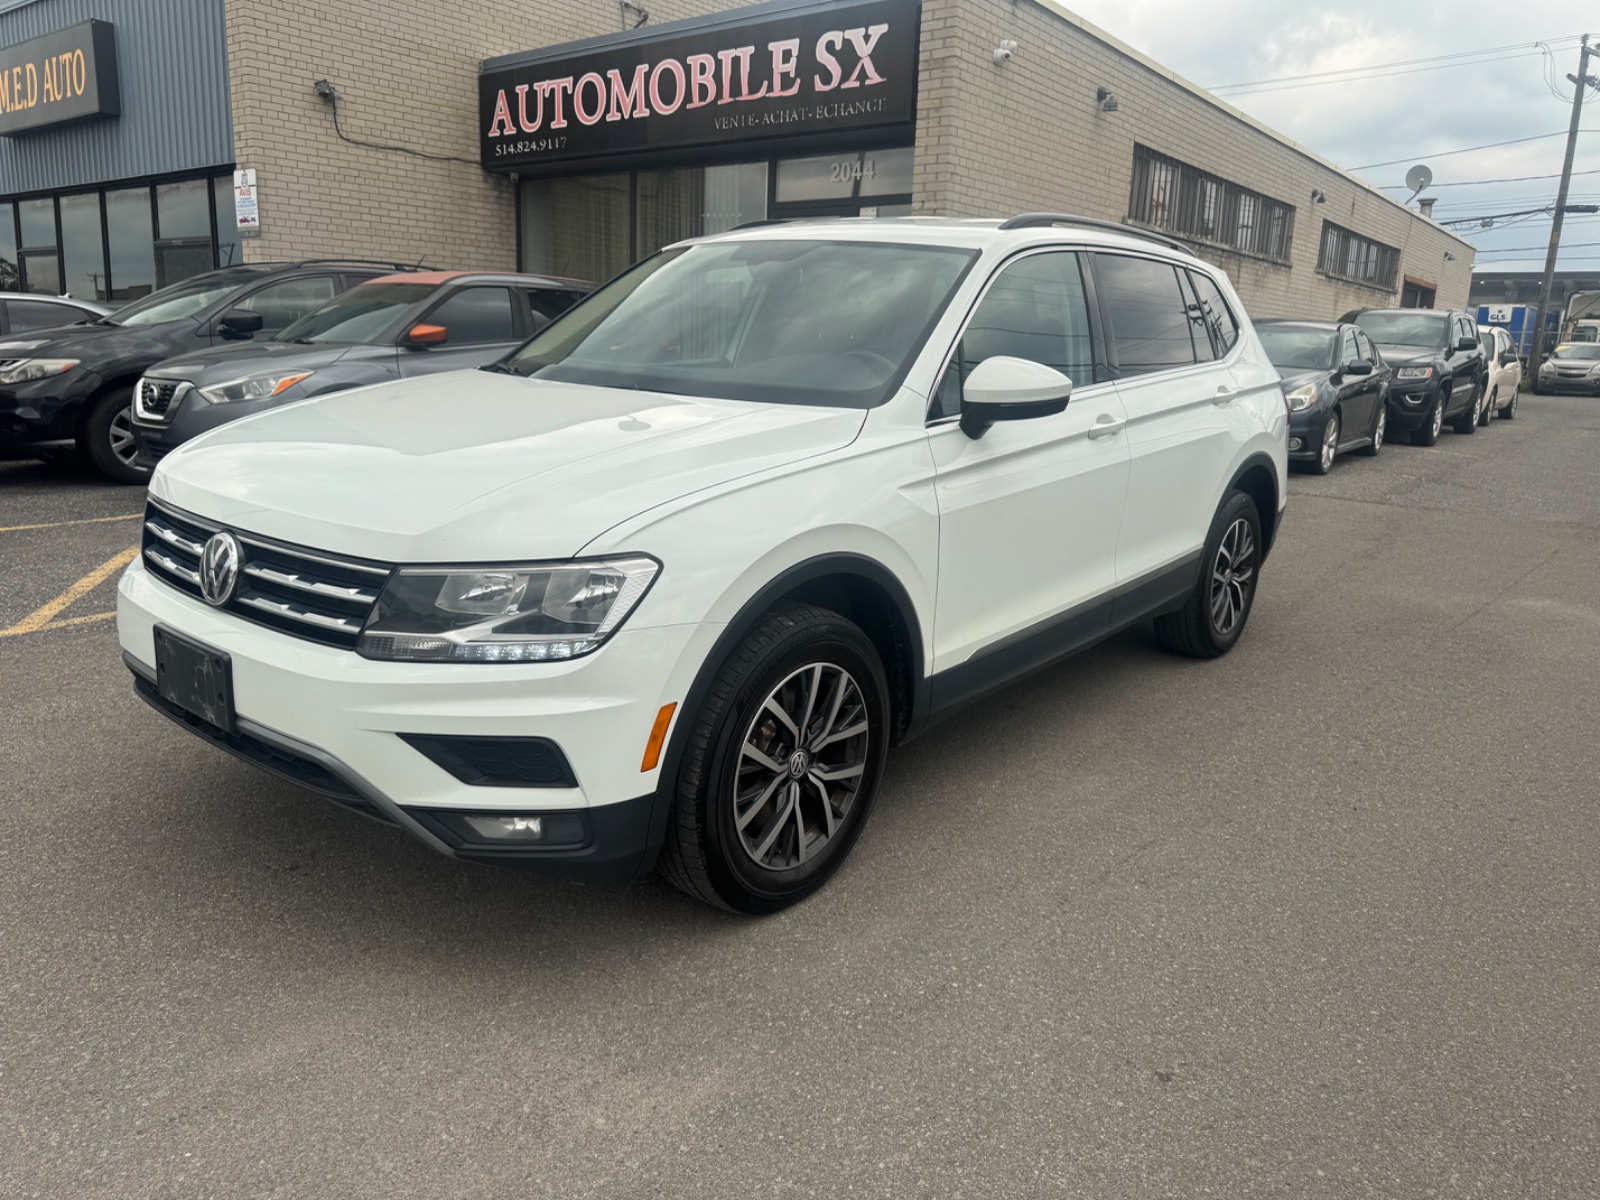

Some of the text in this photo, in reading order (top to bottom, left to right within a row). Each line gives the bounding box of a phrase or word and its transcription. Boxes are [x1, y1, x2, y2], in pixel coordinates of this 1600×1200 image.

[43, 48, 85, 104] AUTO
[488, 23, 890, 137] AUTOMOBILE SX
[495, 137, 567, 157] 514.824.9117
[830, 160, 875, 183] 2044
